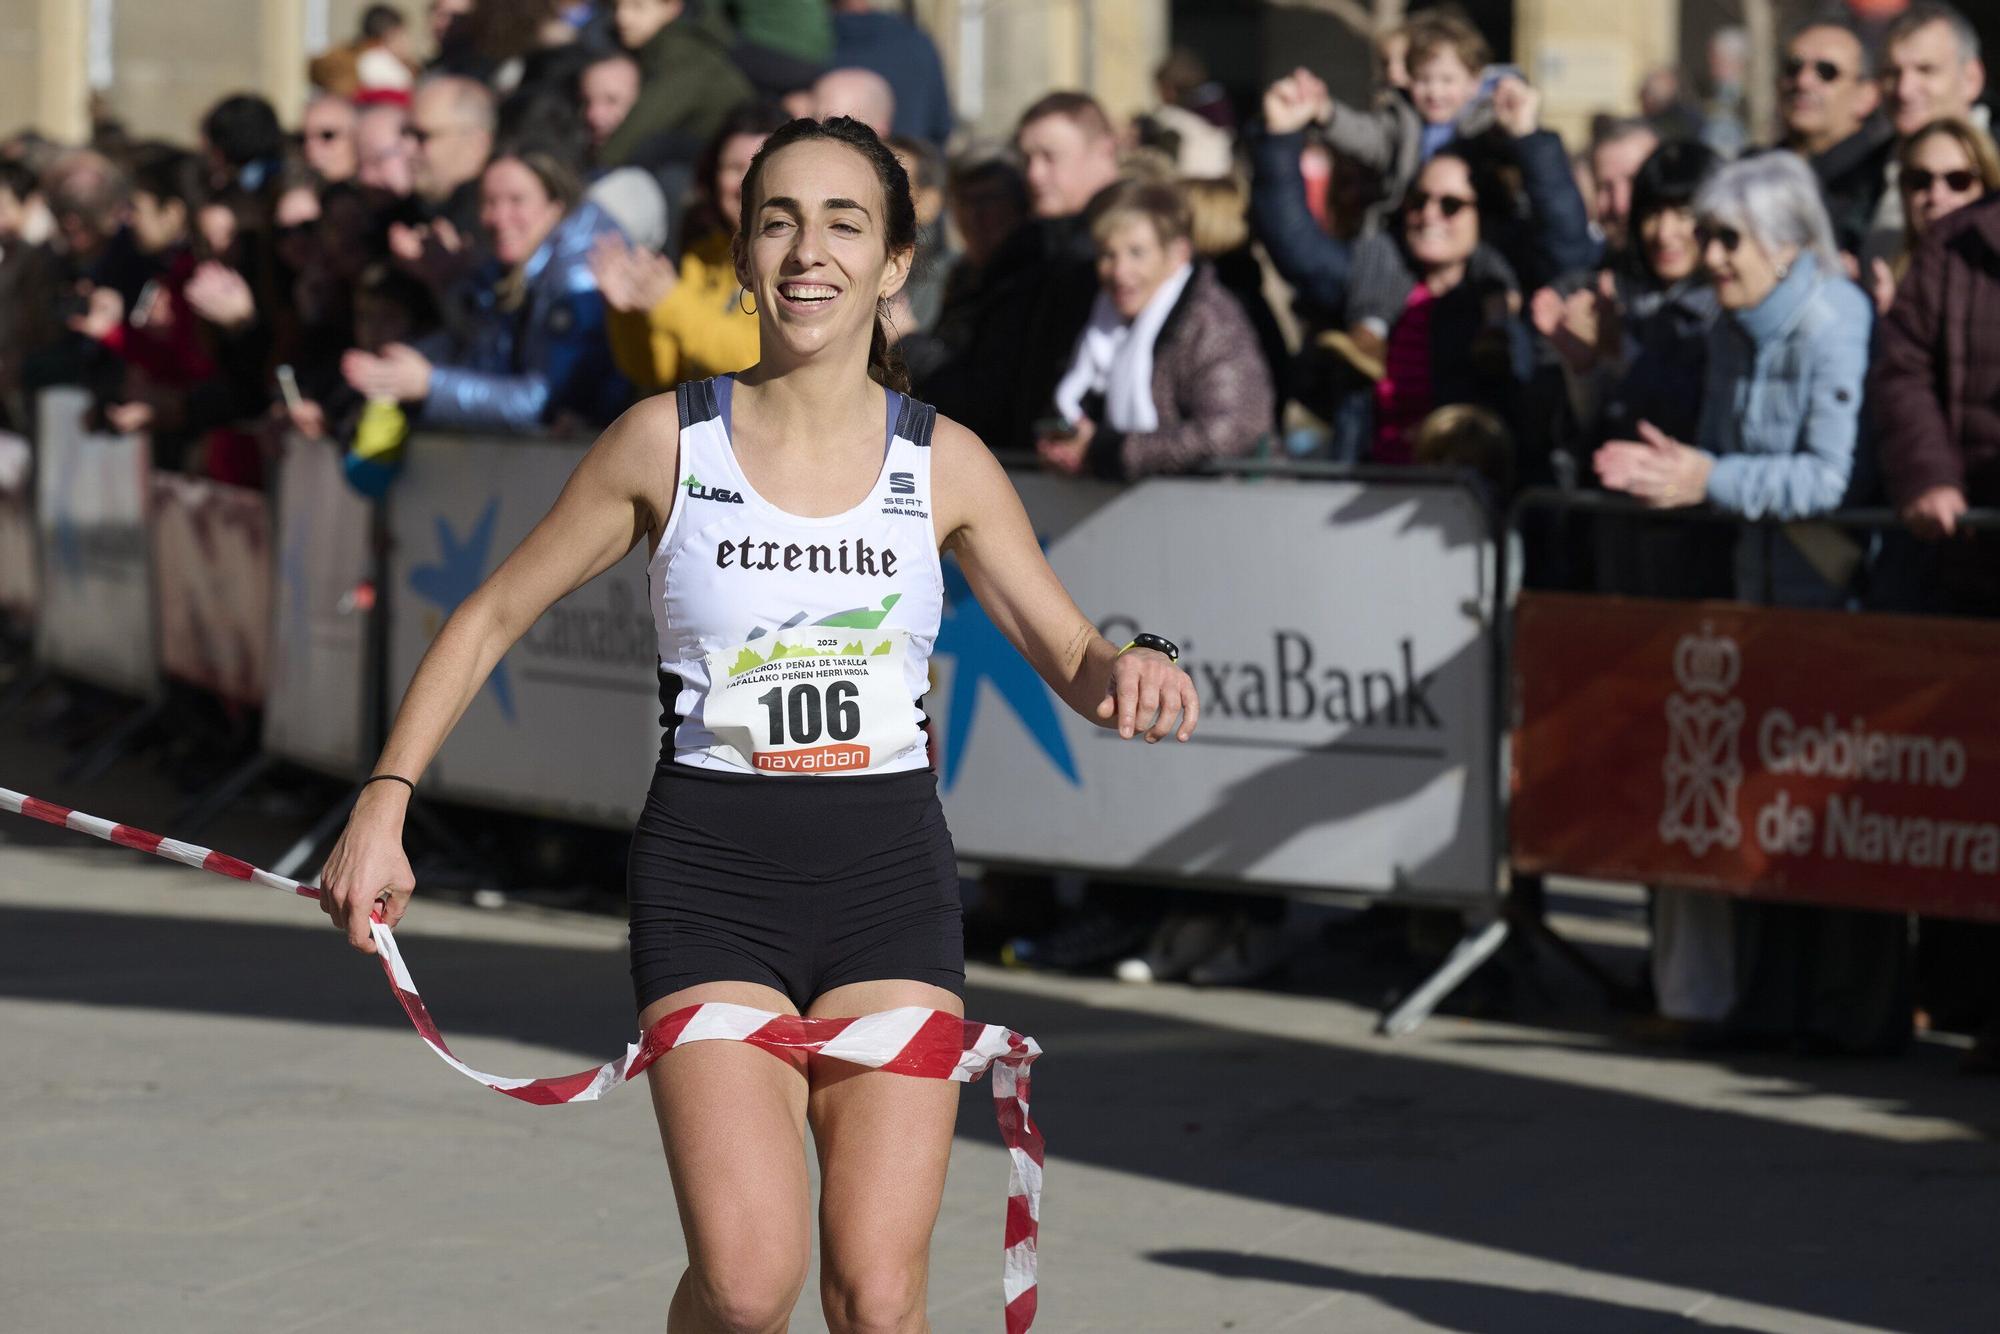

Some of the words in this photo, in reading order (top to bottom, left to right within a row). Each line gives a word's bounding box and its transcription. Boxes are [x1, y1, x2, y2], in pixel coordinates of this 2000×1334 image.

[687, 481, 745, 504] LUGA
[884, 497, 923, 507] SEAT
[904, 509, 929, 519] MOTOR
[716, 535, 898, 578] etxenike
[817, 639, 838, 647] 2025
[755, 662, 782, 673] CROSS
[786, 659, 816, 669] PEÑAS
[819, 659, 831, 667] DE
[833, 659, 867, 667] TAFALLA
[782, 670, 814, 681] PEÑEN
[816, 669, 843, 678] HERRI
[844, 668, 869, 676] KROSA
[757, 680, 861, 746] 106
[1757, 708, 1966, 788] Gobierno
[758, 750, 864, 770] navarban
[1757, 792, 1813, 854] de
[1824, 797, 2000, 874] Navarra
